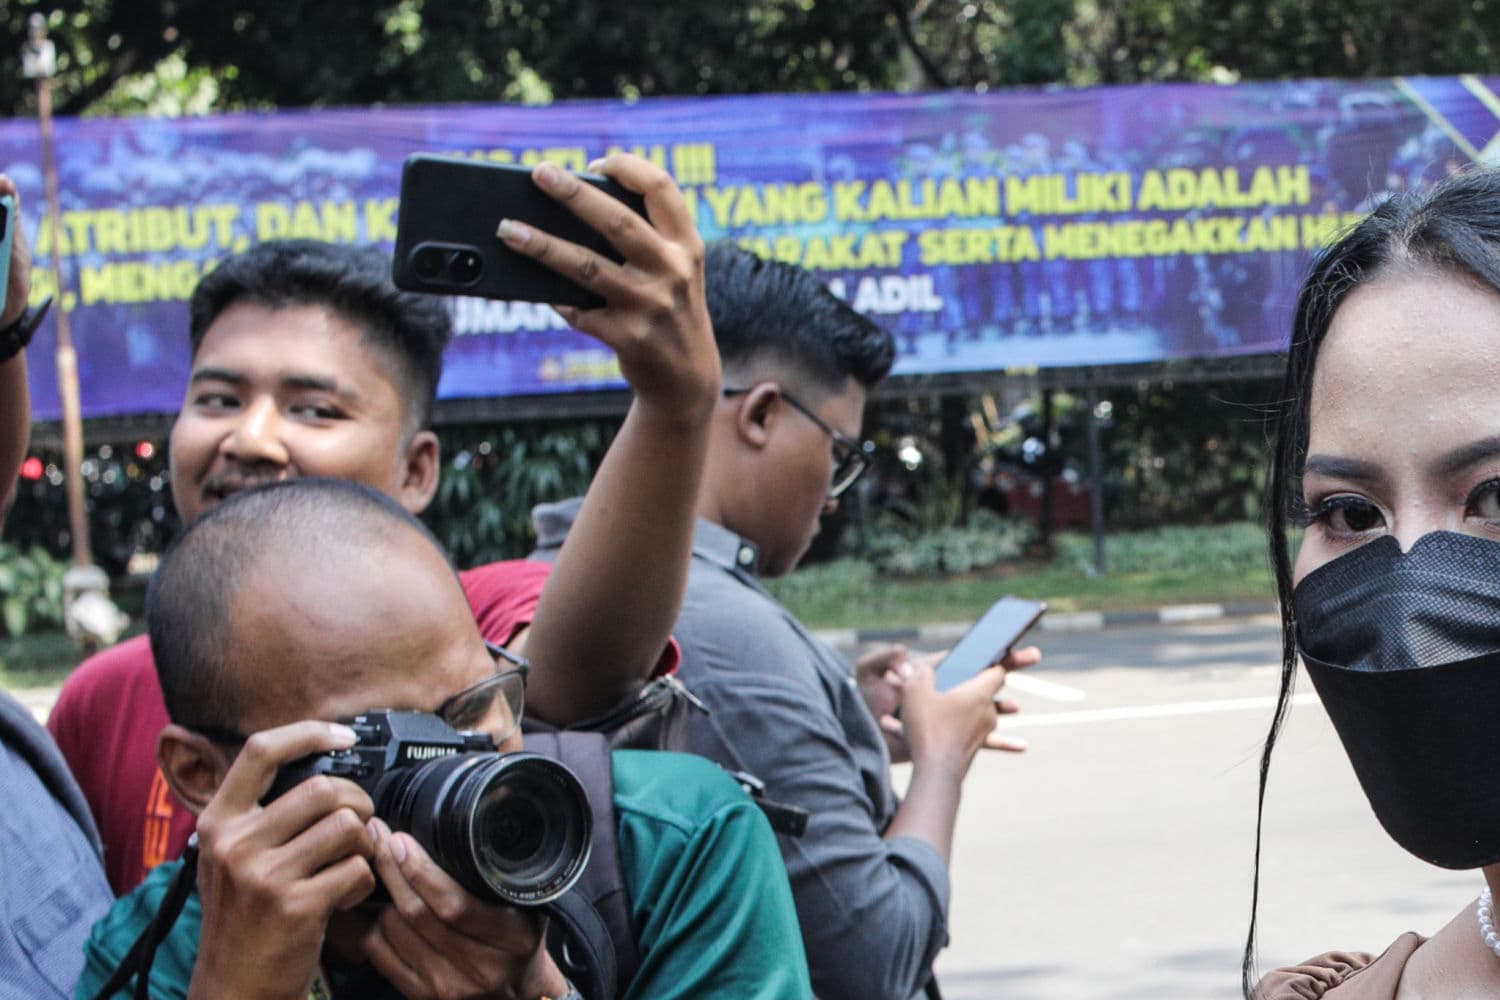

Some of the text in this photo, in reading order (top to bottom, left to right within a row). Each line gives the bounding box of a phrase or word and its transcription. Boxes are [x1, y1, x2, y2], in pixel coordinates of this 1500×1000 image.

[704, 181, 827, 227] YANG
[833, 176, 1001, 222] KALIAN
[1004, 171, 1132, 216] MILIKI
[1137, 165, 1311, 212] ADALAH
[34, 202, 251, 256] ATRIBUT,
[256, 198, 358, 243] DAN
[917, 225, 1041, 266] SERTA
[1043, 213, 1298, 260] MENEGAKKAN
[852, 273, 944, 315] ADIL
